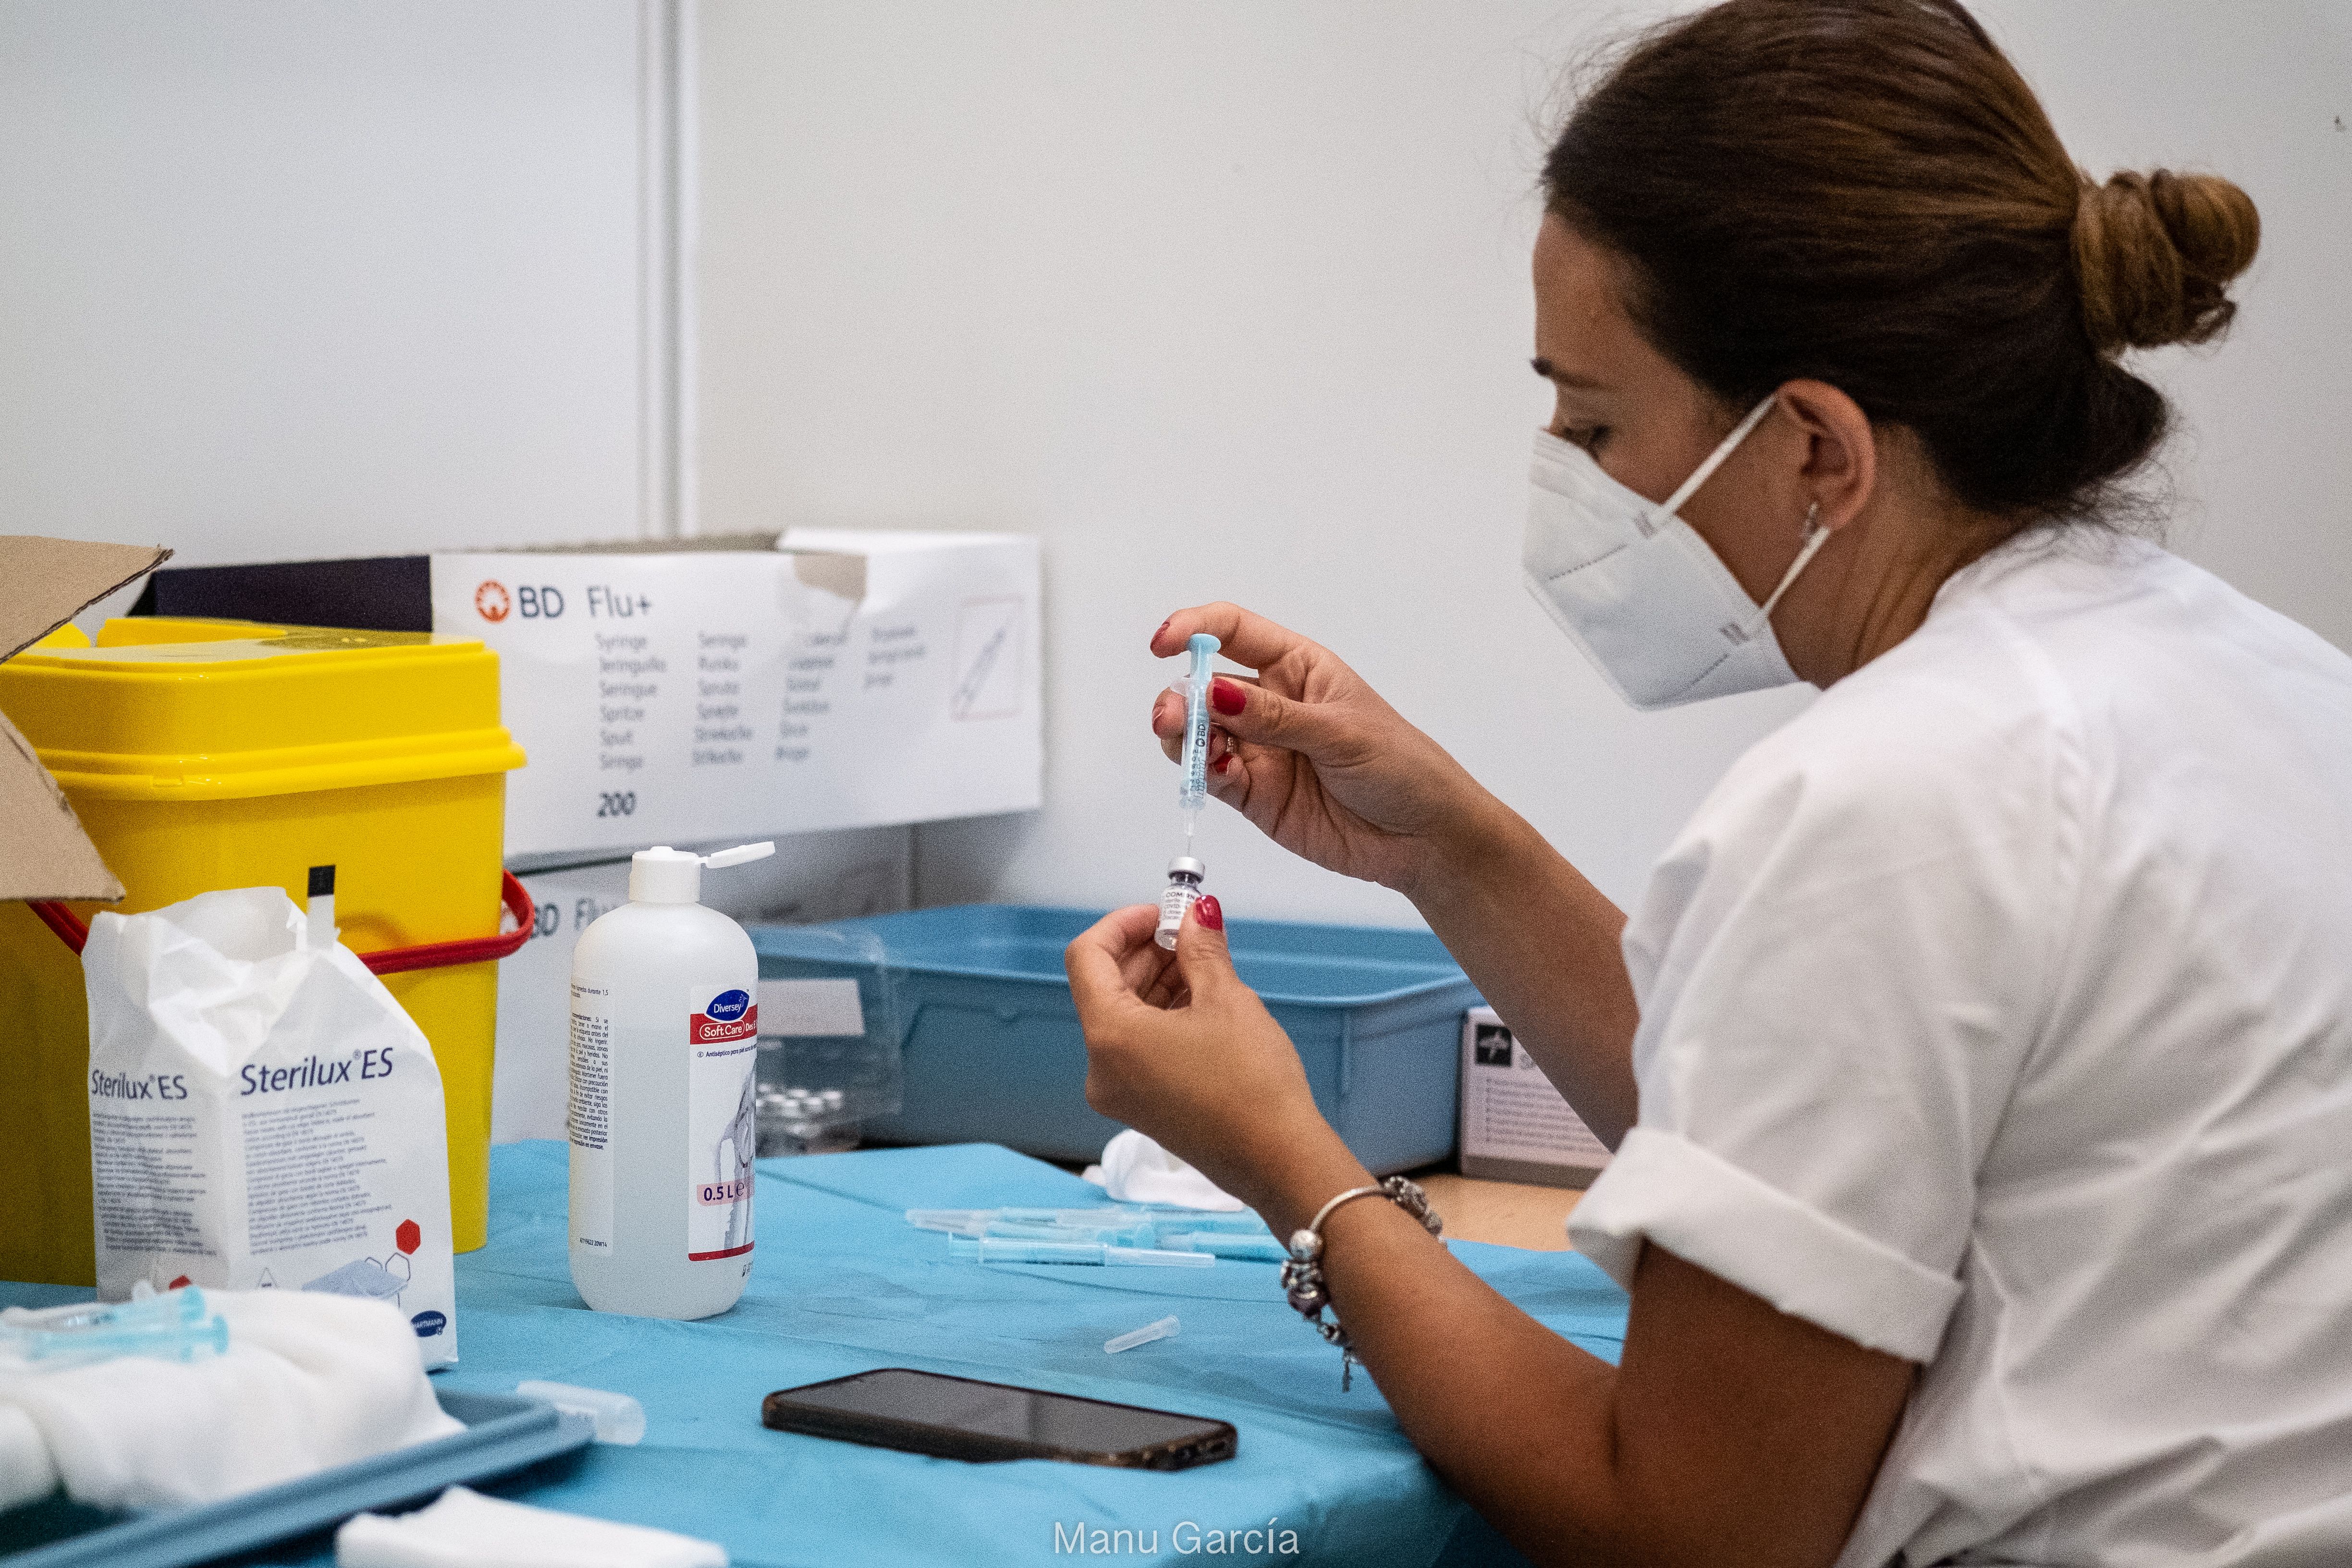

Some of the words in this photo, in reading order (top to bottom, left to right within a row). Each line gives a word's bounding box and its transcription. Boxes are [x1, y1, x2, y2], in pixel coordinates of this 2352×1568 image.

[517, 584, 565, 618] BD
[587, 584, 652, 618] Flu+
[1197, 724, 1206, 736] BD
[597, 791, 636, 817] 200
[713, 1004, 741, 1013] Diversey
[704, 1025, 724, 1037] Soft
[725, 1024, 742, 1035] Care
[745, 1023, 753, 1032] Des
[361, 1047, 393, 1080] ES
[158, 1074, 188, 1100] ES
[703, 1186, 724, 1201] 0.5
[727, 1185, 734, 1199] L
